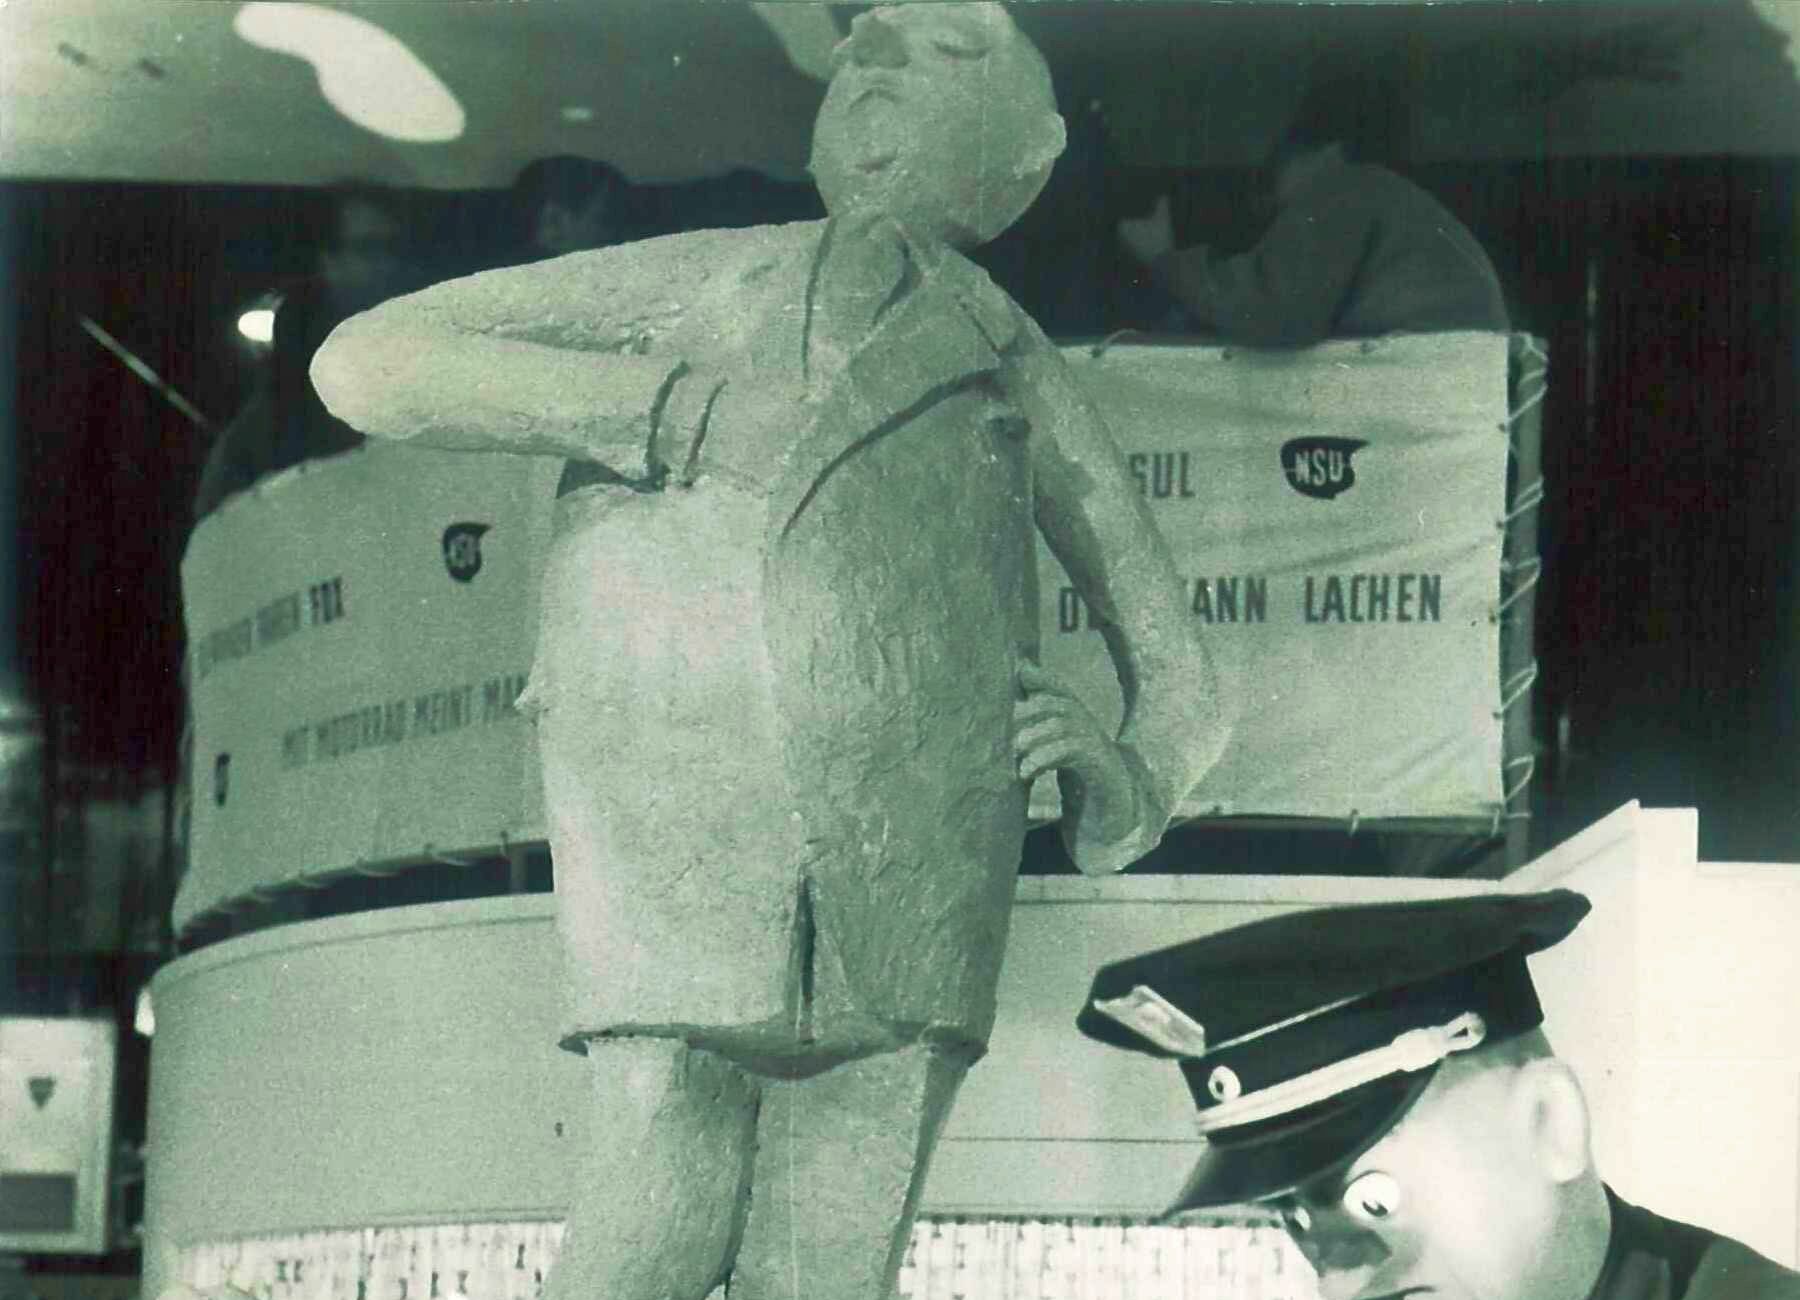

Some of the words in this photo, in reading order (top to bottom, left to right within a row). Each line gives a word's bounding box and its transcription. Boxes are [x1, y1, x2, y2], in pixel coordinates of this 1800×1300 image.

[1295, 447, 1344, 486] NSU
[1185, 576, 1267, 623] ANN
[1304, 573, 1442, 623] LACHEN
